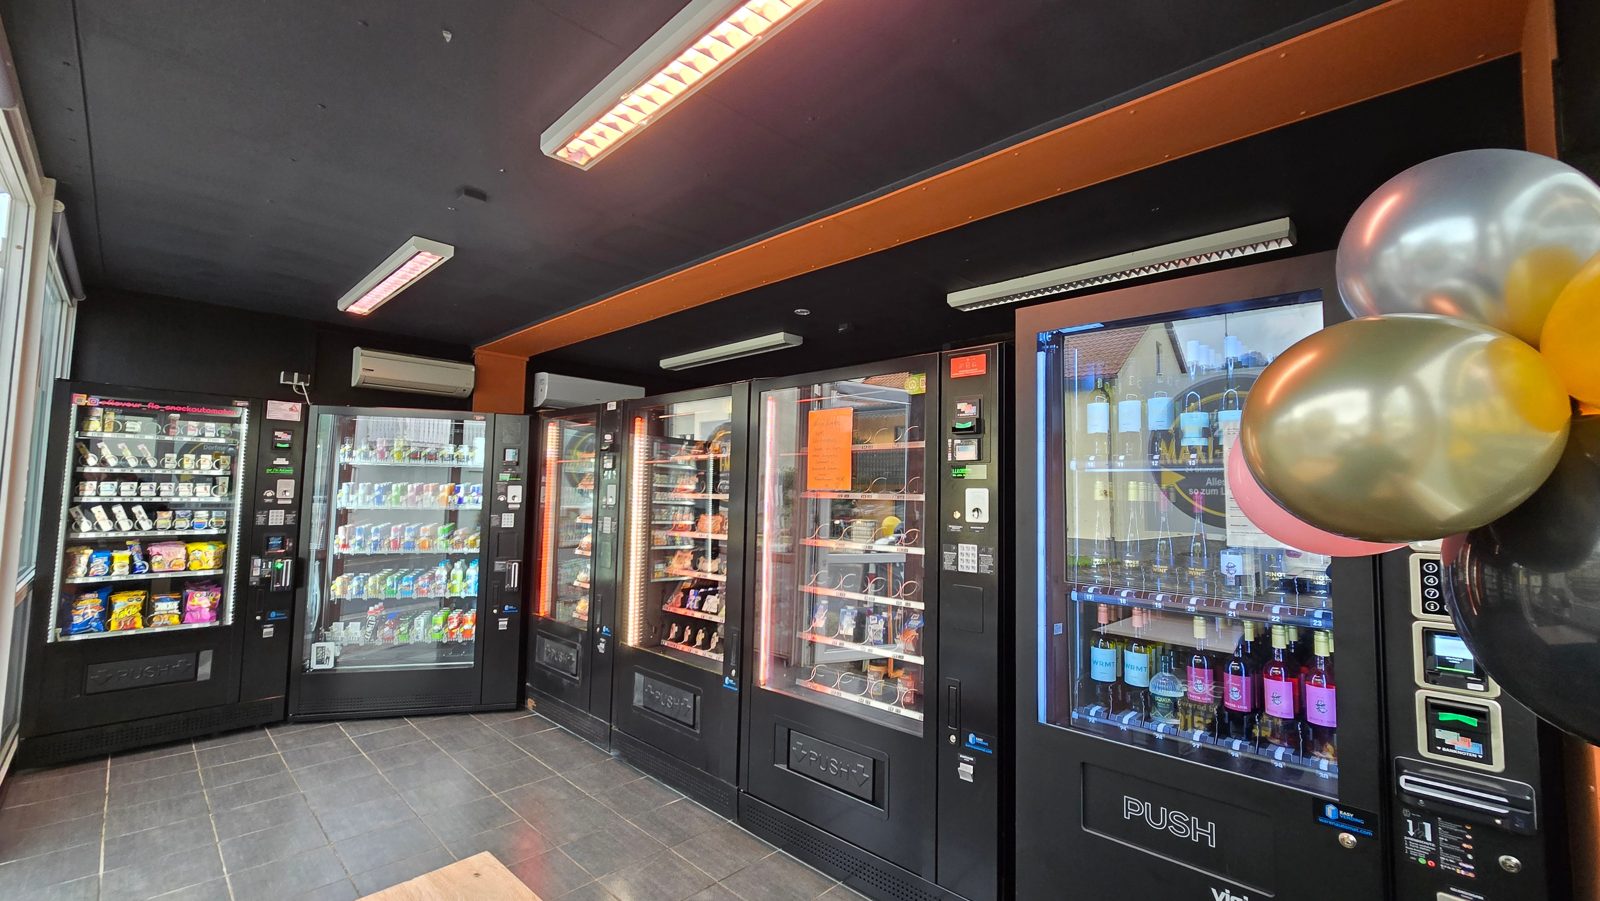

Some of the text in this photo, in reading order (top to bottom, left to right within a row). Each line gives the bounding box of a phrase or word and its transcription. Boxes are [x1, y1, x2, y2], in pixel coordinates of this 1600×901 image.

[1092, 660, 1116, 669] WRMT
[1125, 662, 1148, 672] WRMT
[808, 749, 850, 780] PUSH
[1123, 795, 1216, 848] PUSH
